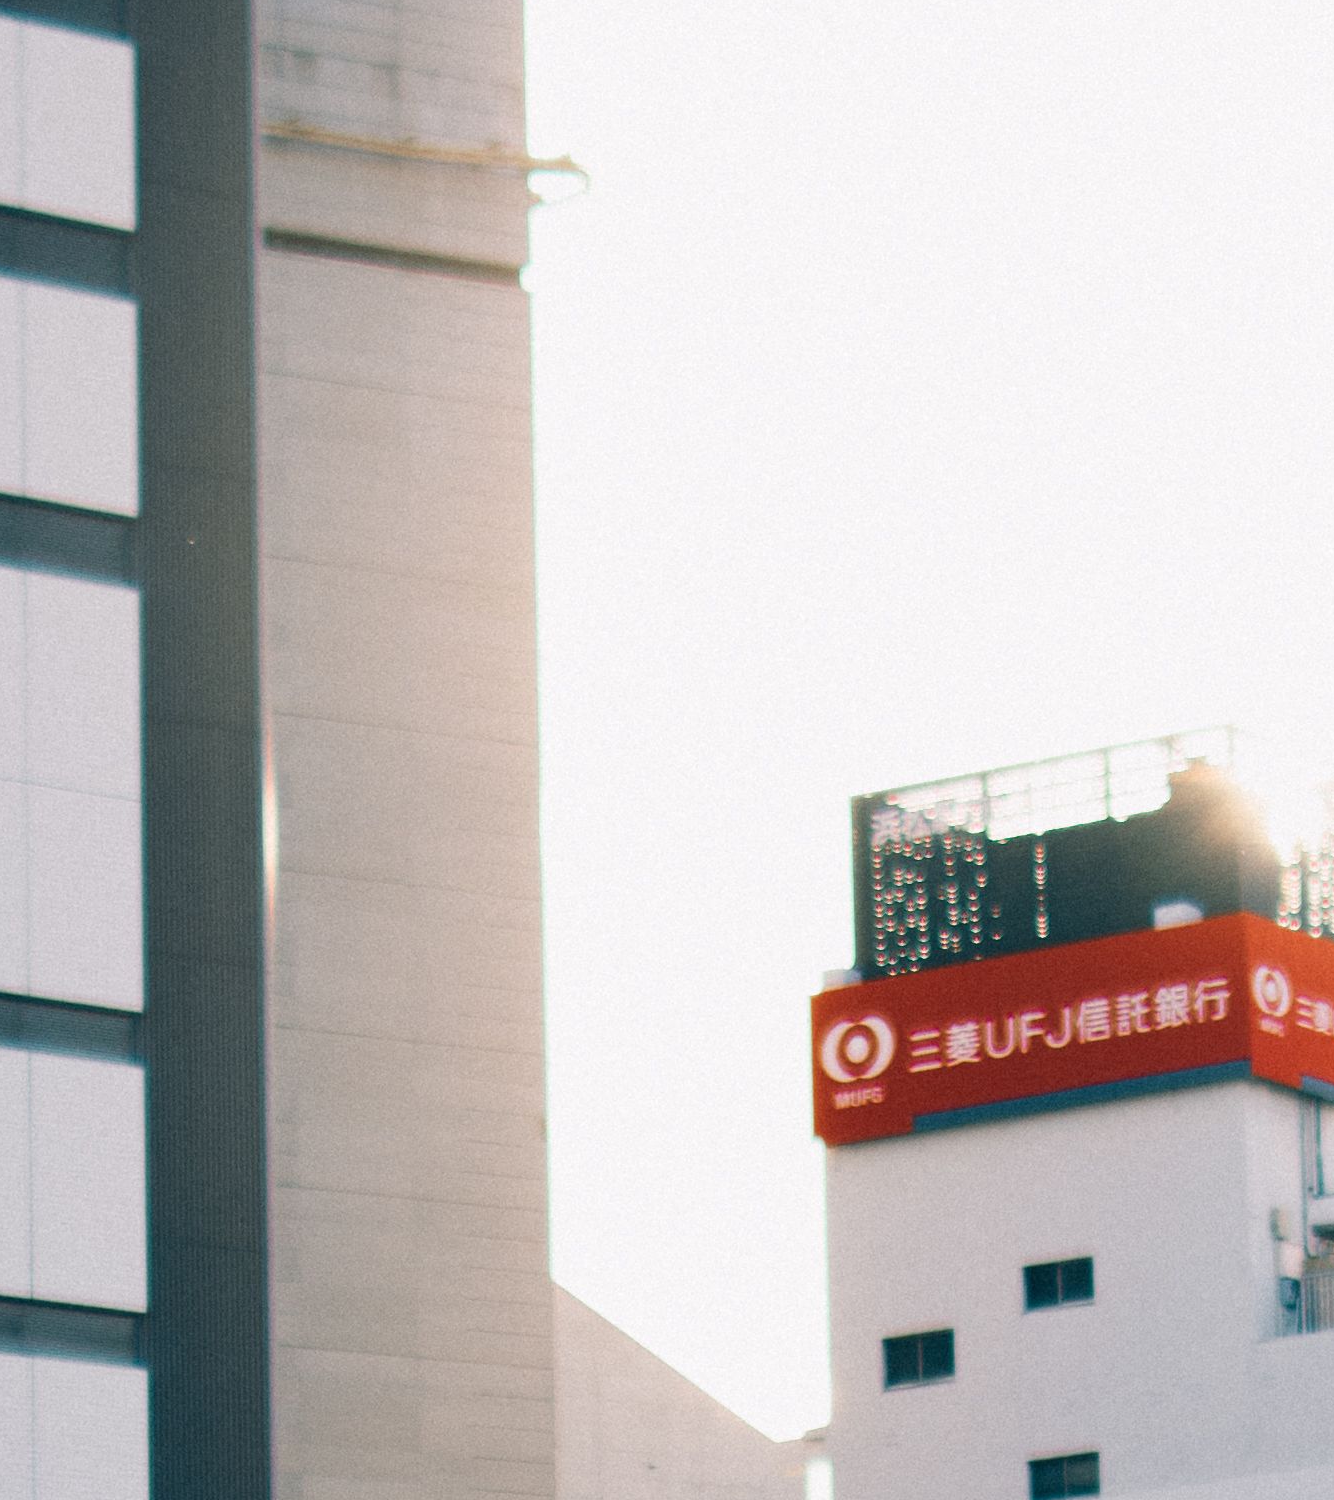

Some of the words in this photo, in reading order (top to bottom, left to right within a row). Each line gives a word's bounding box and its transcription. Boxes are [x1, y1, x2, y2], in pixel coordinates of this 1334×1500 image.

[908, 976, 1232, 1072] 三菱UFJ信託銀行
